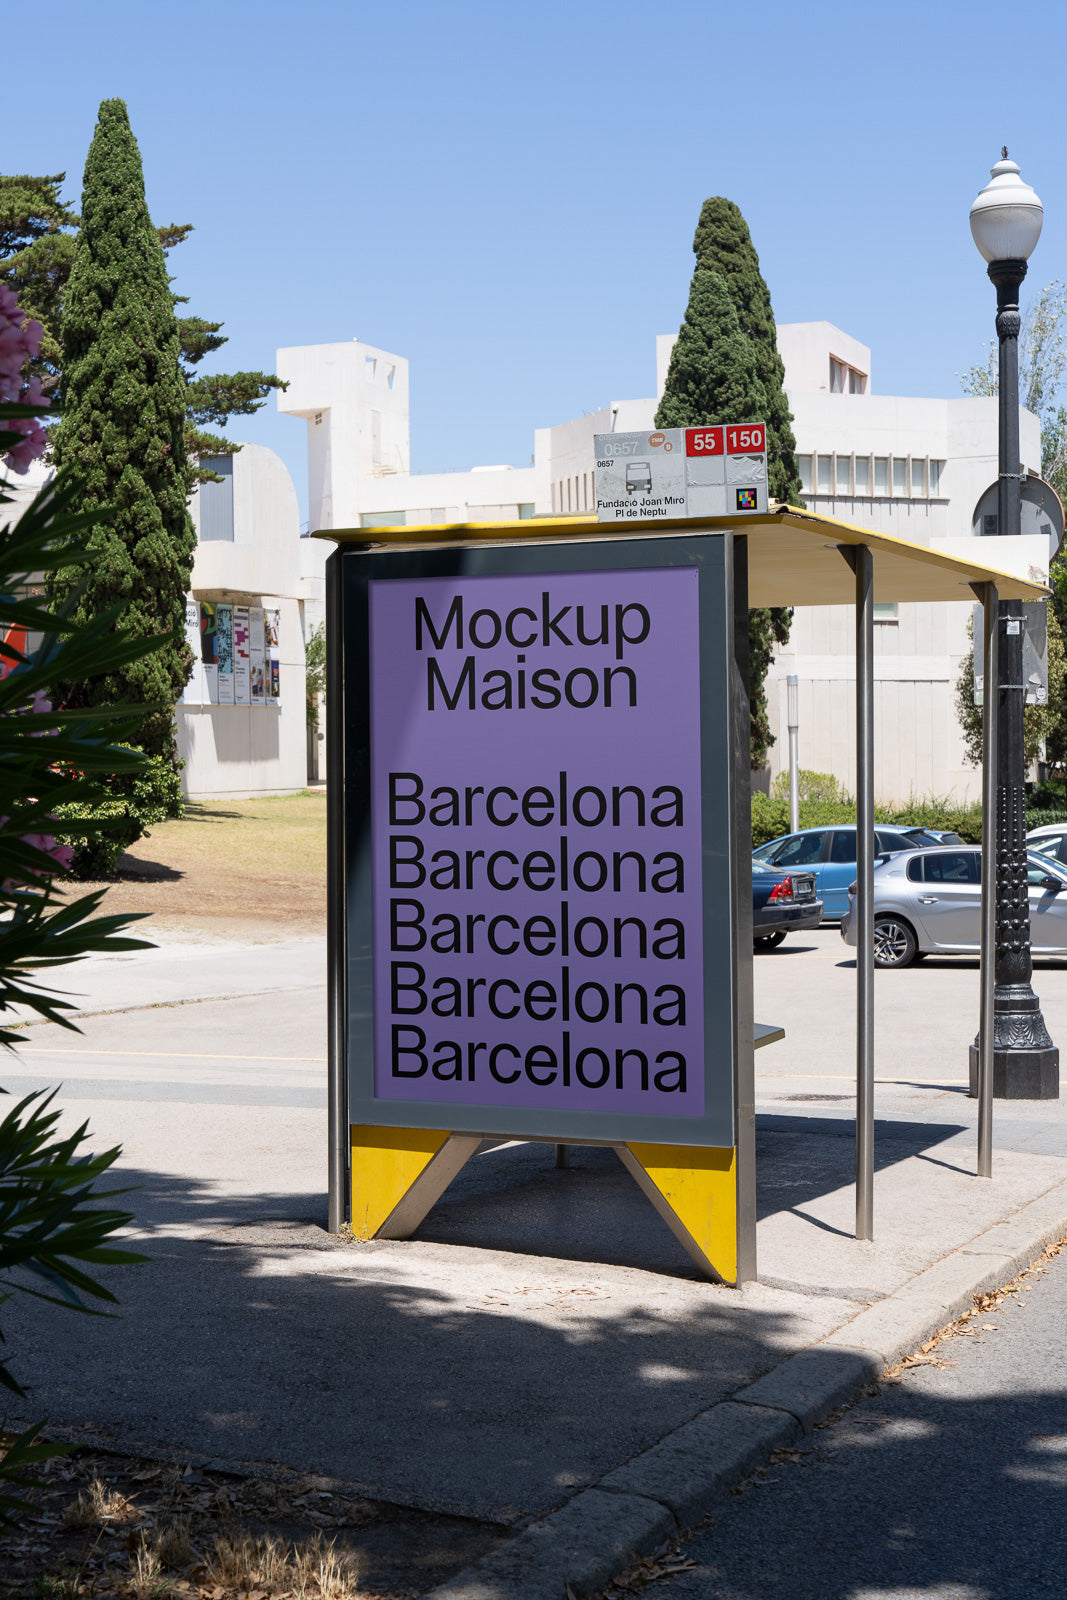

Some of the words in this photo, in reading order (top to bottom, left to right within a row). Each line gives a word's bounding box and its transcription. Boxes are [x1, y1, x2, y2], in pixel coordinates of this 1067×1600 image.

[597, 460, 614, 468] 0657
[604, 441, 639, 457] 0657
[694, 433, 716, 451] 55
[729, 430, 762, 448] 150
[626, 508, 638, 517] de
[640, 497, 662, 506] Joan
[415, 592, 650, 659] Mockup
[428, 655, 637, 711] Maison
[388, 772, 684, 827] Barcelona
[389, 836, 685, 893] Barcelona
[390, 898, 686, 959] Barcelona
[391, 961, 687, 1026] Barcelona
[391, 1024, 687, 1092] Barcelona
